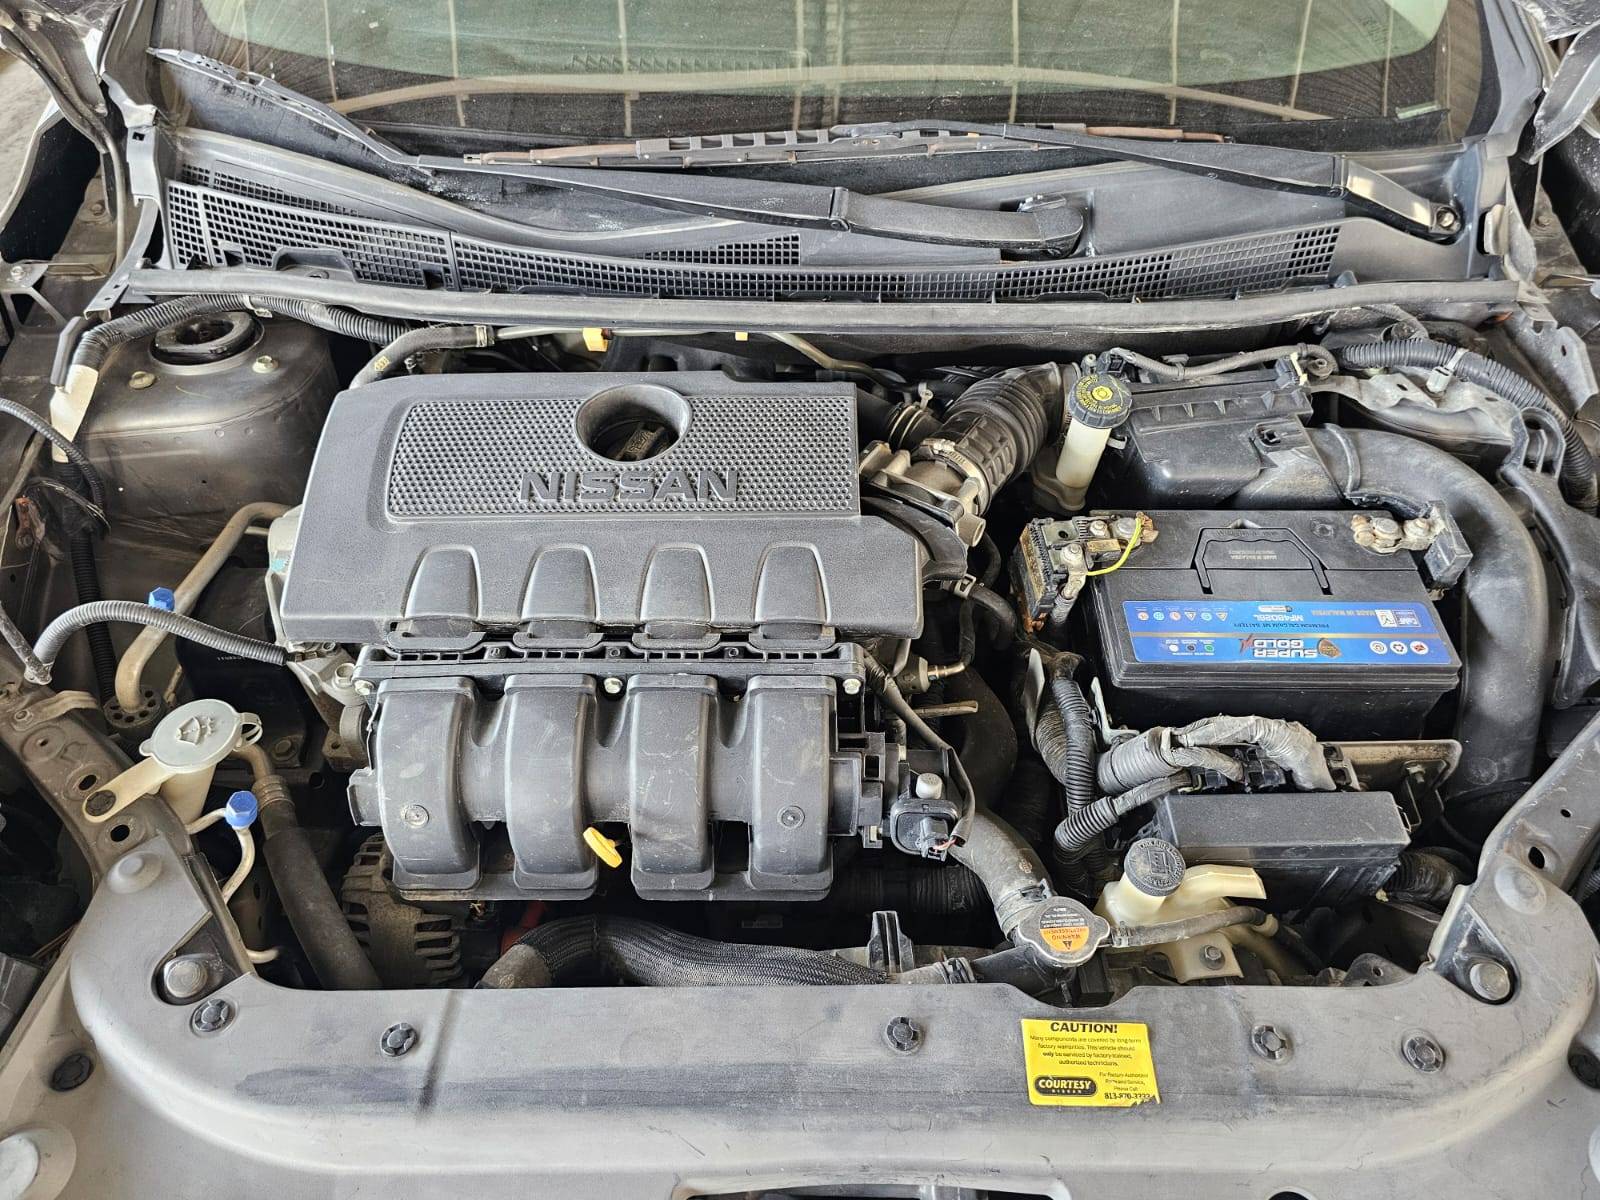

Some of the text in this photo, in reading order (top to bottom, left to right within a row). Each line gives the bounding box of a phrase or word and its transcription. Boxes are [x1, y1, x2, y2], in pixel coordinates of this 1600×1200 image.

[520, 470, 738, 502] NISSAN
[1253, 639, 1304, 648] GOLD
[1253, 649, 1318, 658] SUPER
[1050, 1021, 1118, 1033] CAUTION!
[1038, 1079, 1092, 1090] COURTESY
